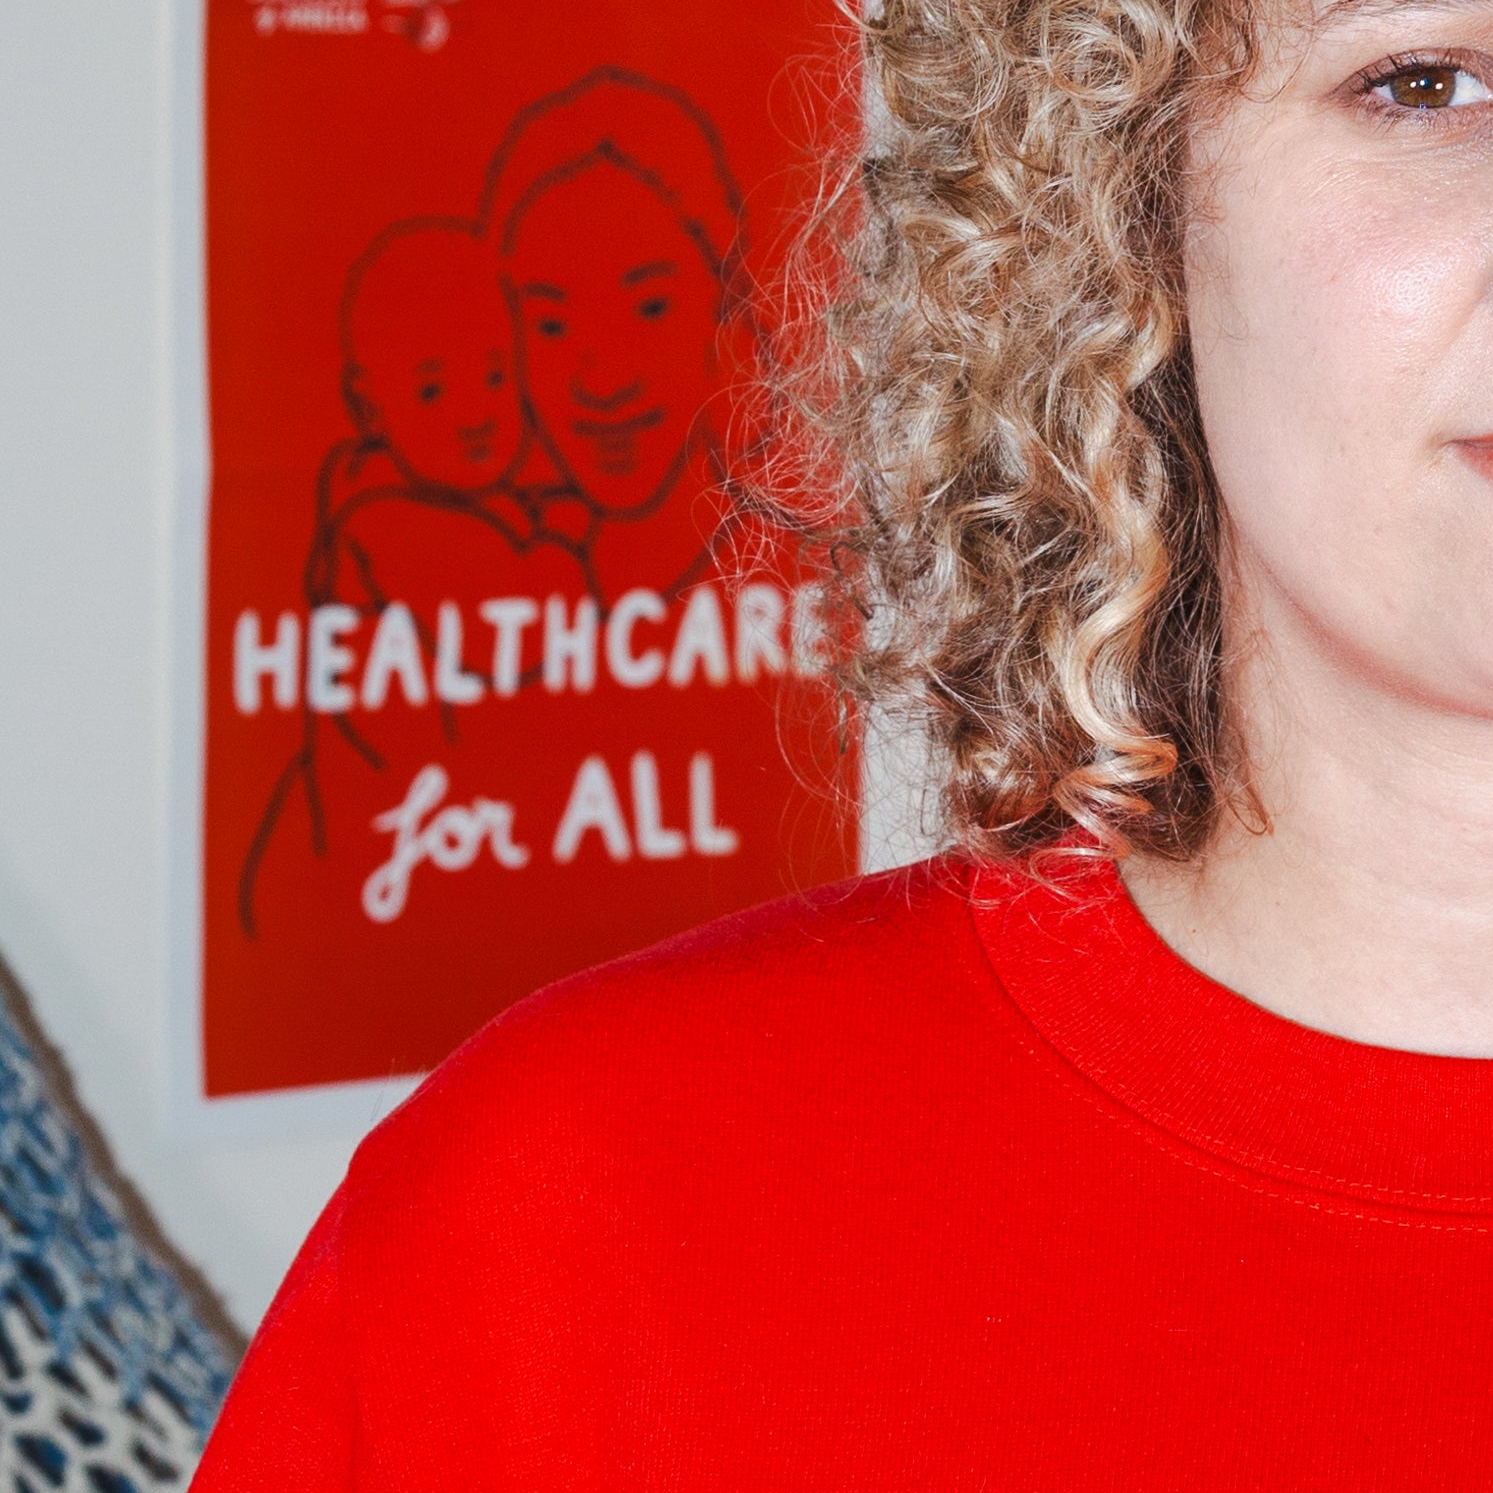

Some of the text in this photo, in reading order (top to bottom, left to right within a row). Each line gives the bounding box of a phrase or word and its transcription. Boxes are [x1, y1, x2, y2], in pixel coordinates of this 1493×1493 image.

[233, 582, 832, 715] HEALTHCARE
[360, 750, 738, 924] for ALL
